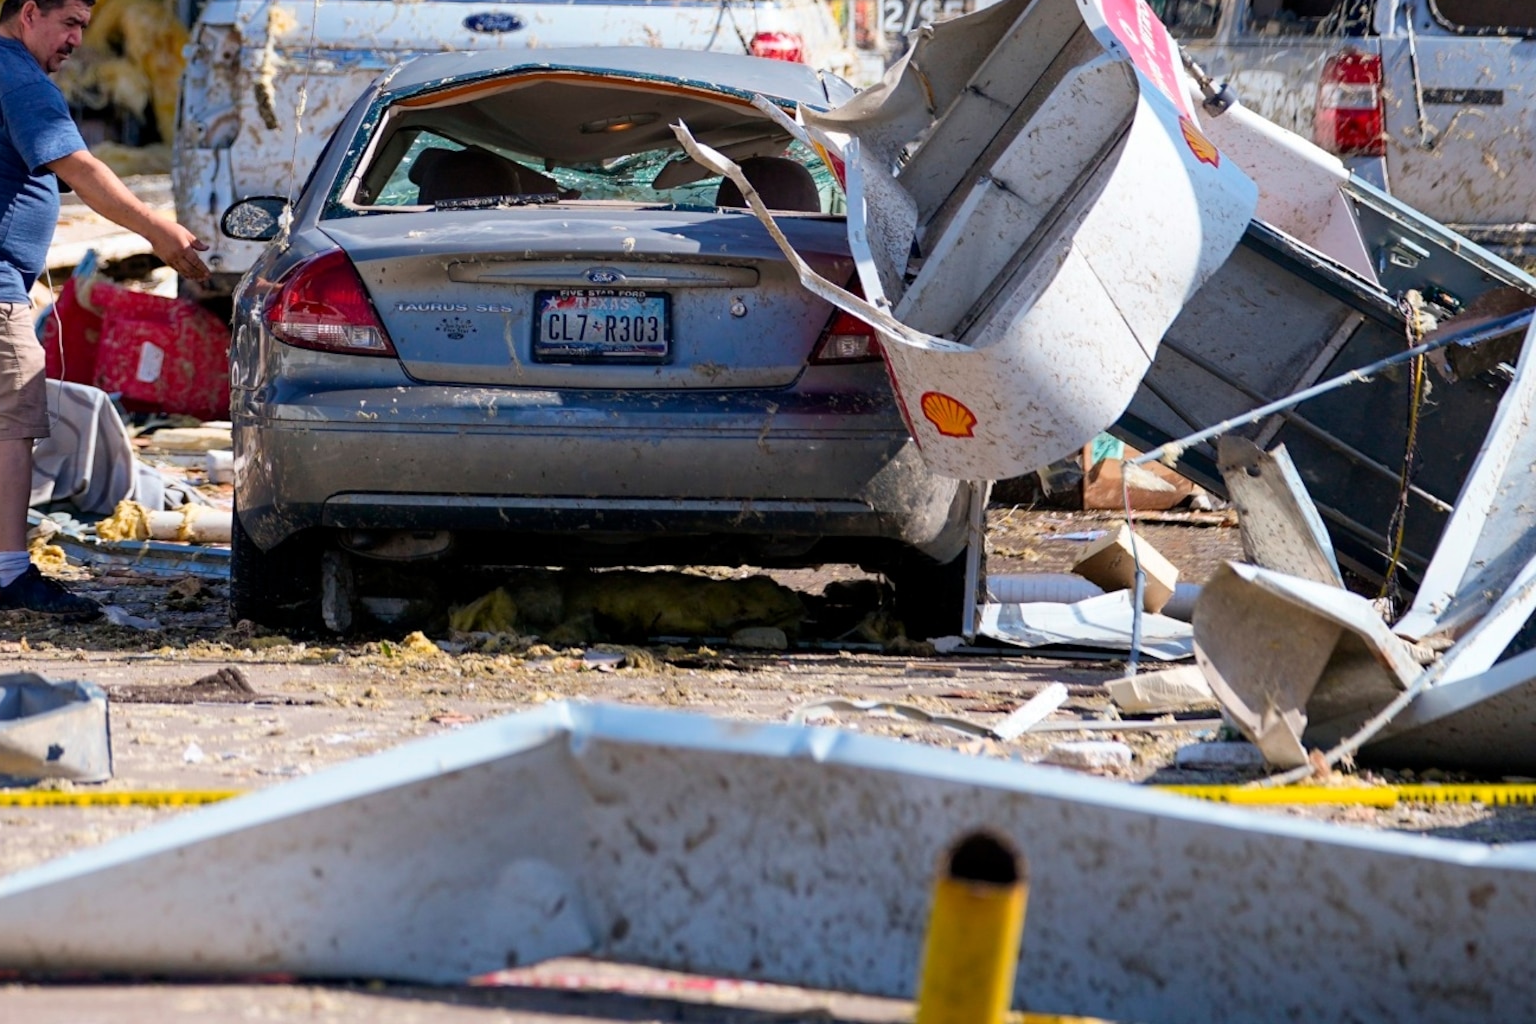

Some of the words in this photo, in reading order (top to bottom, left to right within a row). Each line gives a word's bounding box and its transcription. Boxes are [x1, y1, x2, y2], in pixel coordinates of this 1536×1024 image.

[560, 289, 584, 297] FIVE
[620, 290, 646, 298] FORD
[396, 302, 468, 312] TAURUS
[476, 304, 513, 313] SES
[575, 297, 630, 311] TEXAS
[549, 314, 588, 341] CL7
[605, 315, 659, 343] R303
